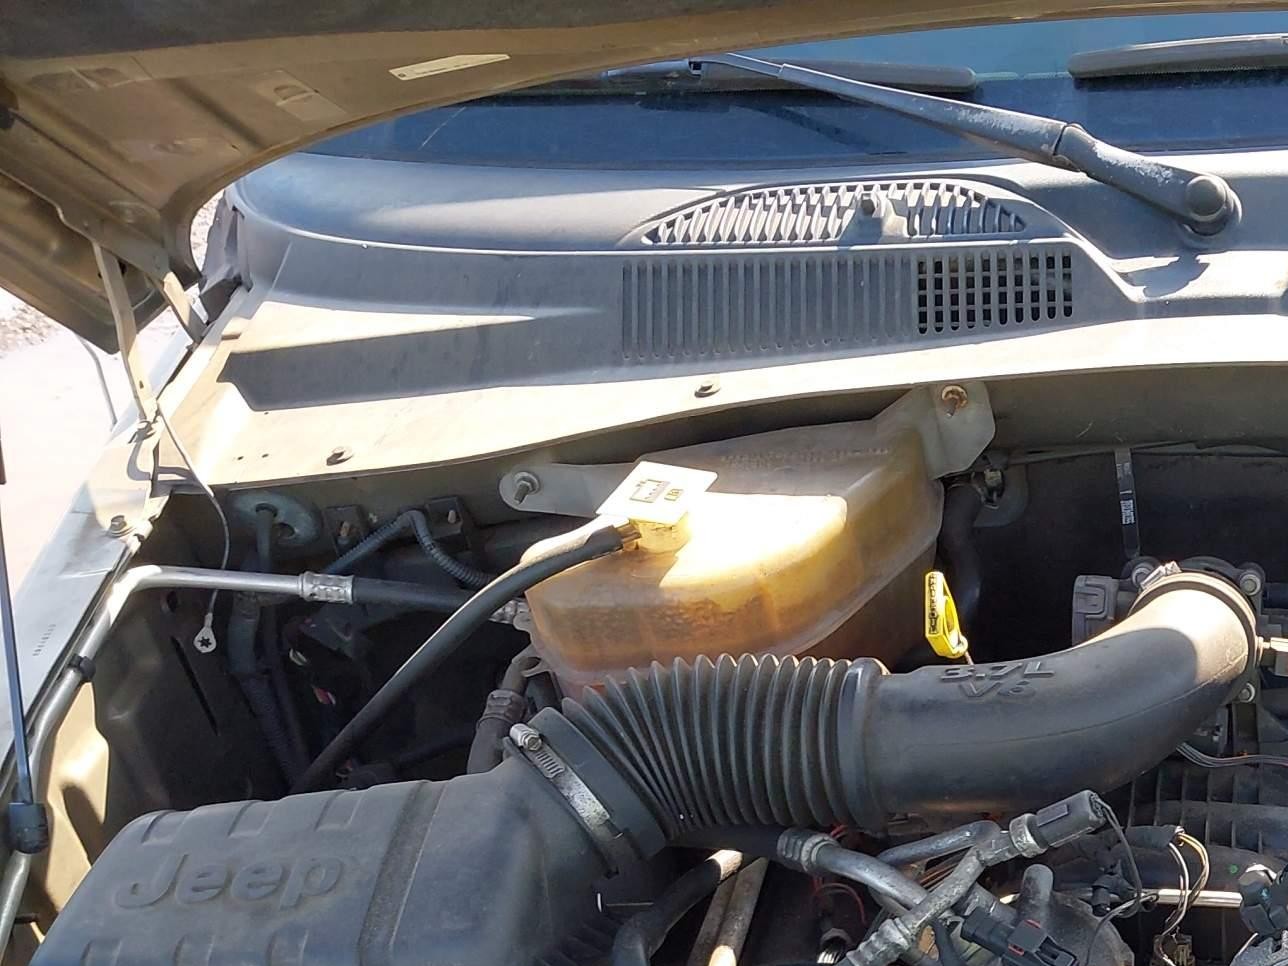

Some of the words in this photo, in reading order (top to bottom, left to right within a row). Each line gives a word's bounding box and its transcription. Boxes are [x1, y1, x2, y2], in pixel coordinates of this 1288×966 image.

[940, 661, 1055, 681] 3.7L
[958, 680, 1036, 698] V6
[114, 852, 346, 912] Jeep
